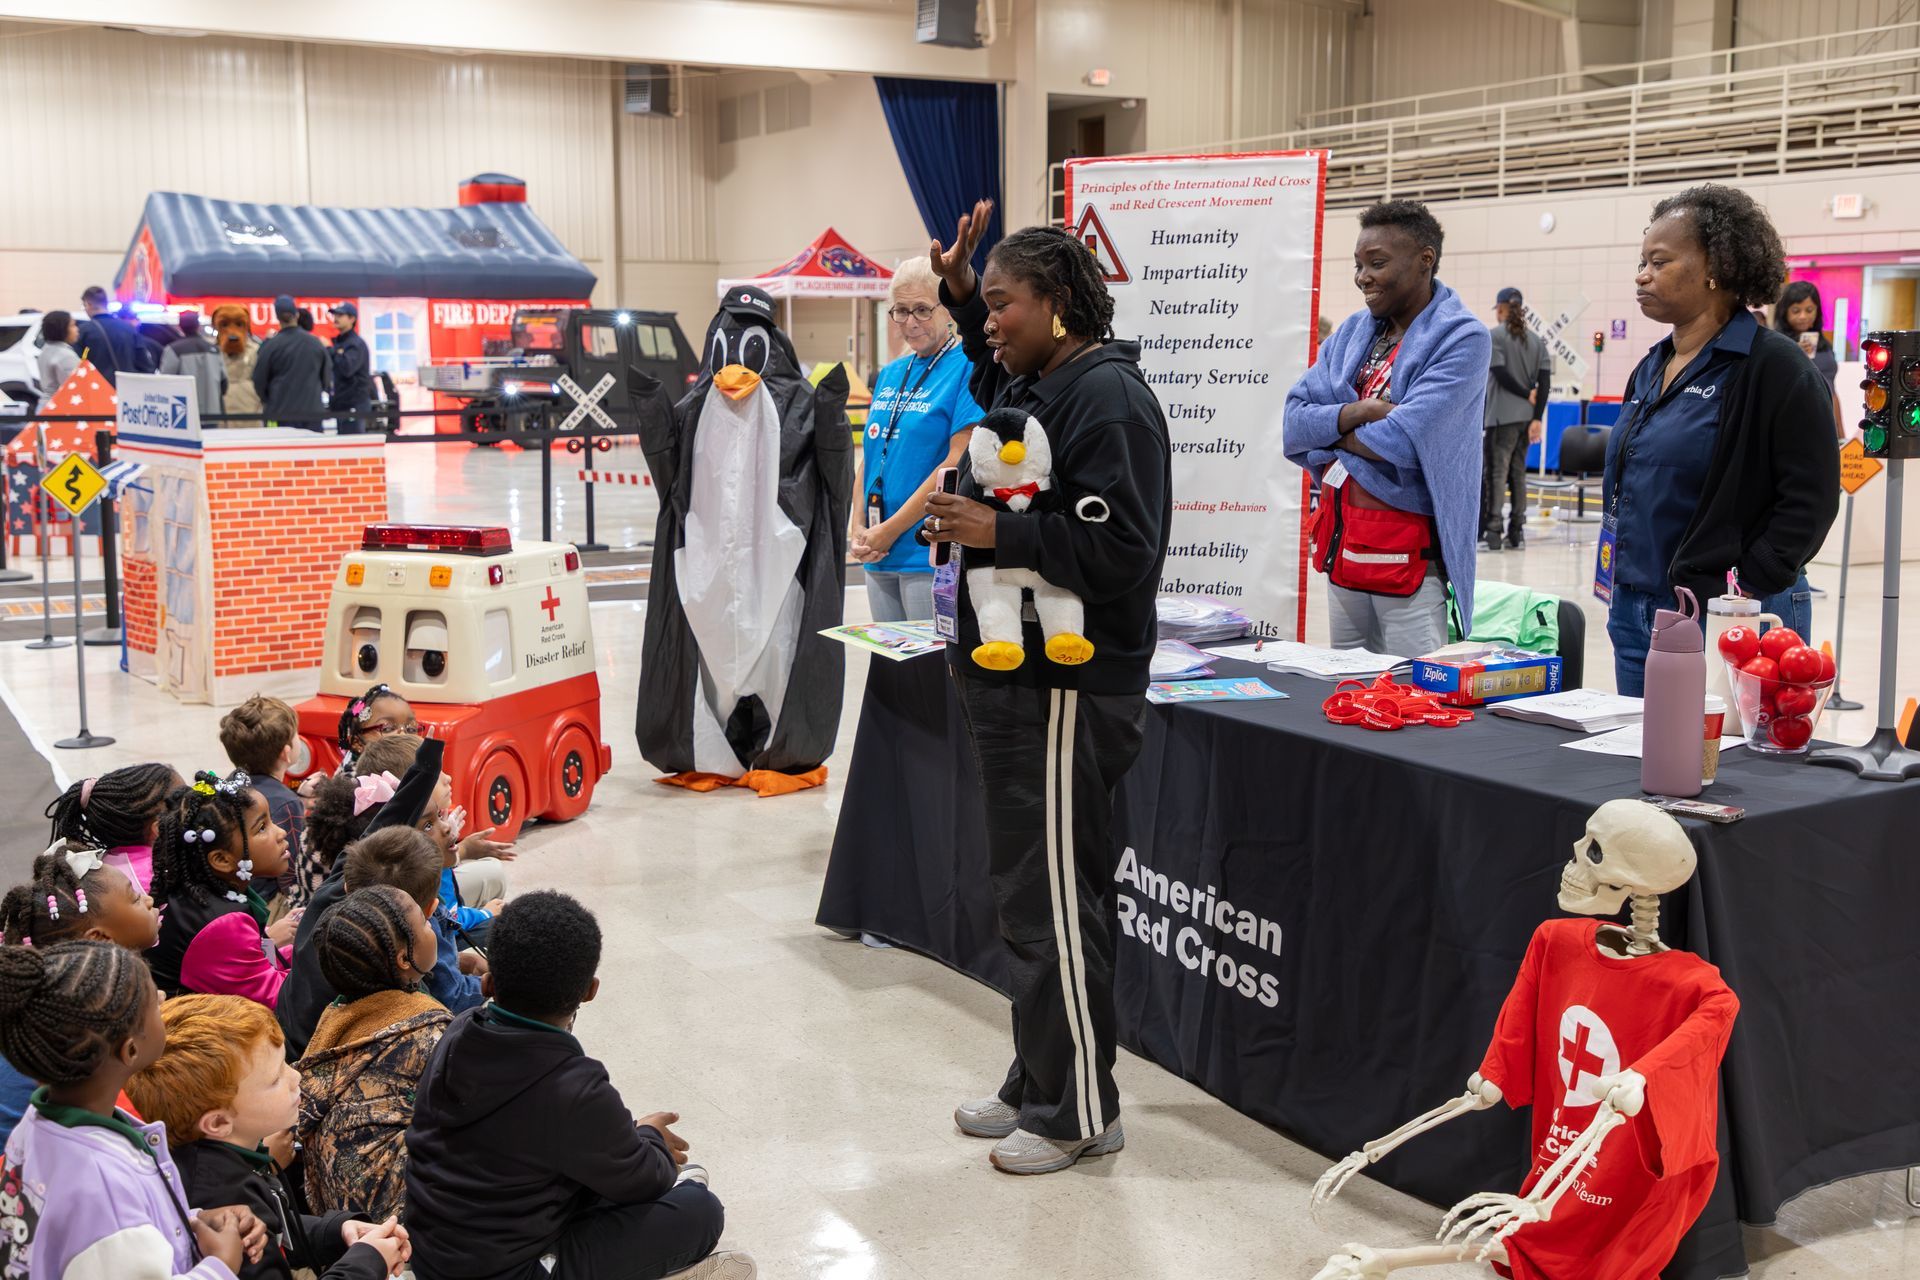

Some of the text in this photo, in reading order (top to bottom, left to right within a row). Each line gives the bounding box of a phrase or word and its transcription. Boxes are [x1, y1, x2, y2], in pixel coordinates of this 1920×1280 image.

[1081, 175, 1311, 195] Principles of the International Red Cross
[1109, 196, 1272, 210] and Red Crescent Movement
[1150, 228, 1239, 248] Humanity
[1142, 263, 1248, 285] Impartiality
[432, 303, 474, 325] FIRE
[1149, 298, 1239, 319] Neutrality
[1137, 334, 1254, 355] Independence
[561, 377, 583, 400] RAIL
[1143, 368, 1269, 389] luntary Service
[122, 402, 169, 428] Post Office
[1168, 404, 1216, 424] Unity
[1172, 437, 1245, 458] versality
[1219, 501, 1267, 513] Behaviors
[1167, 542, 1248, 563] untability
[1159, 578, 1243, 597] laboration
[541, 624, 564, 633] American
[552, 633, 566, 641] Cross
[1250, 620, 1278, 637] ults
[526, 641, 586, 668] Disaster Relief
[1424, 667, 1448, 682] Ziploc
[1549, 664, 1559, 692] Ziploc
[1114, 846, 1282, 957] American
[1117, 893, 1280, 1008] Red Cross
